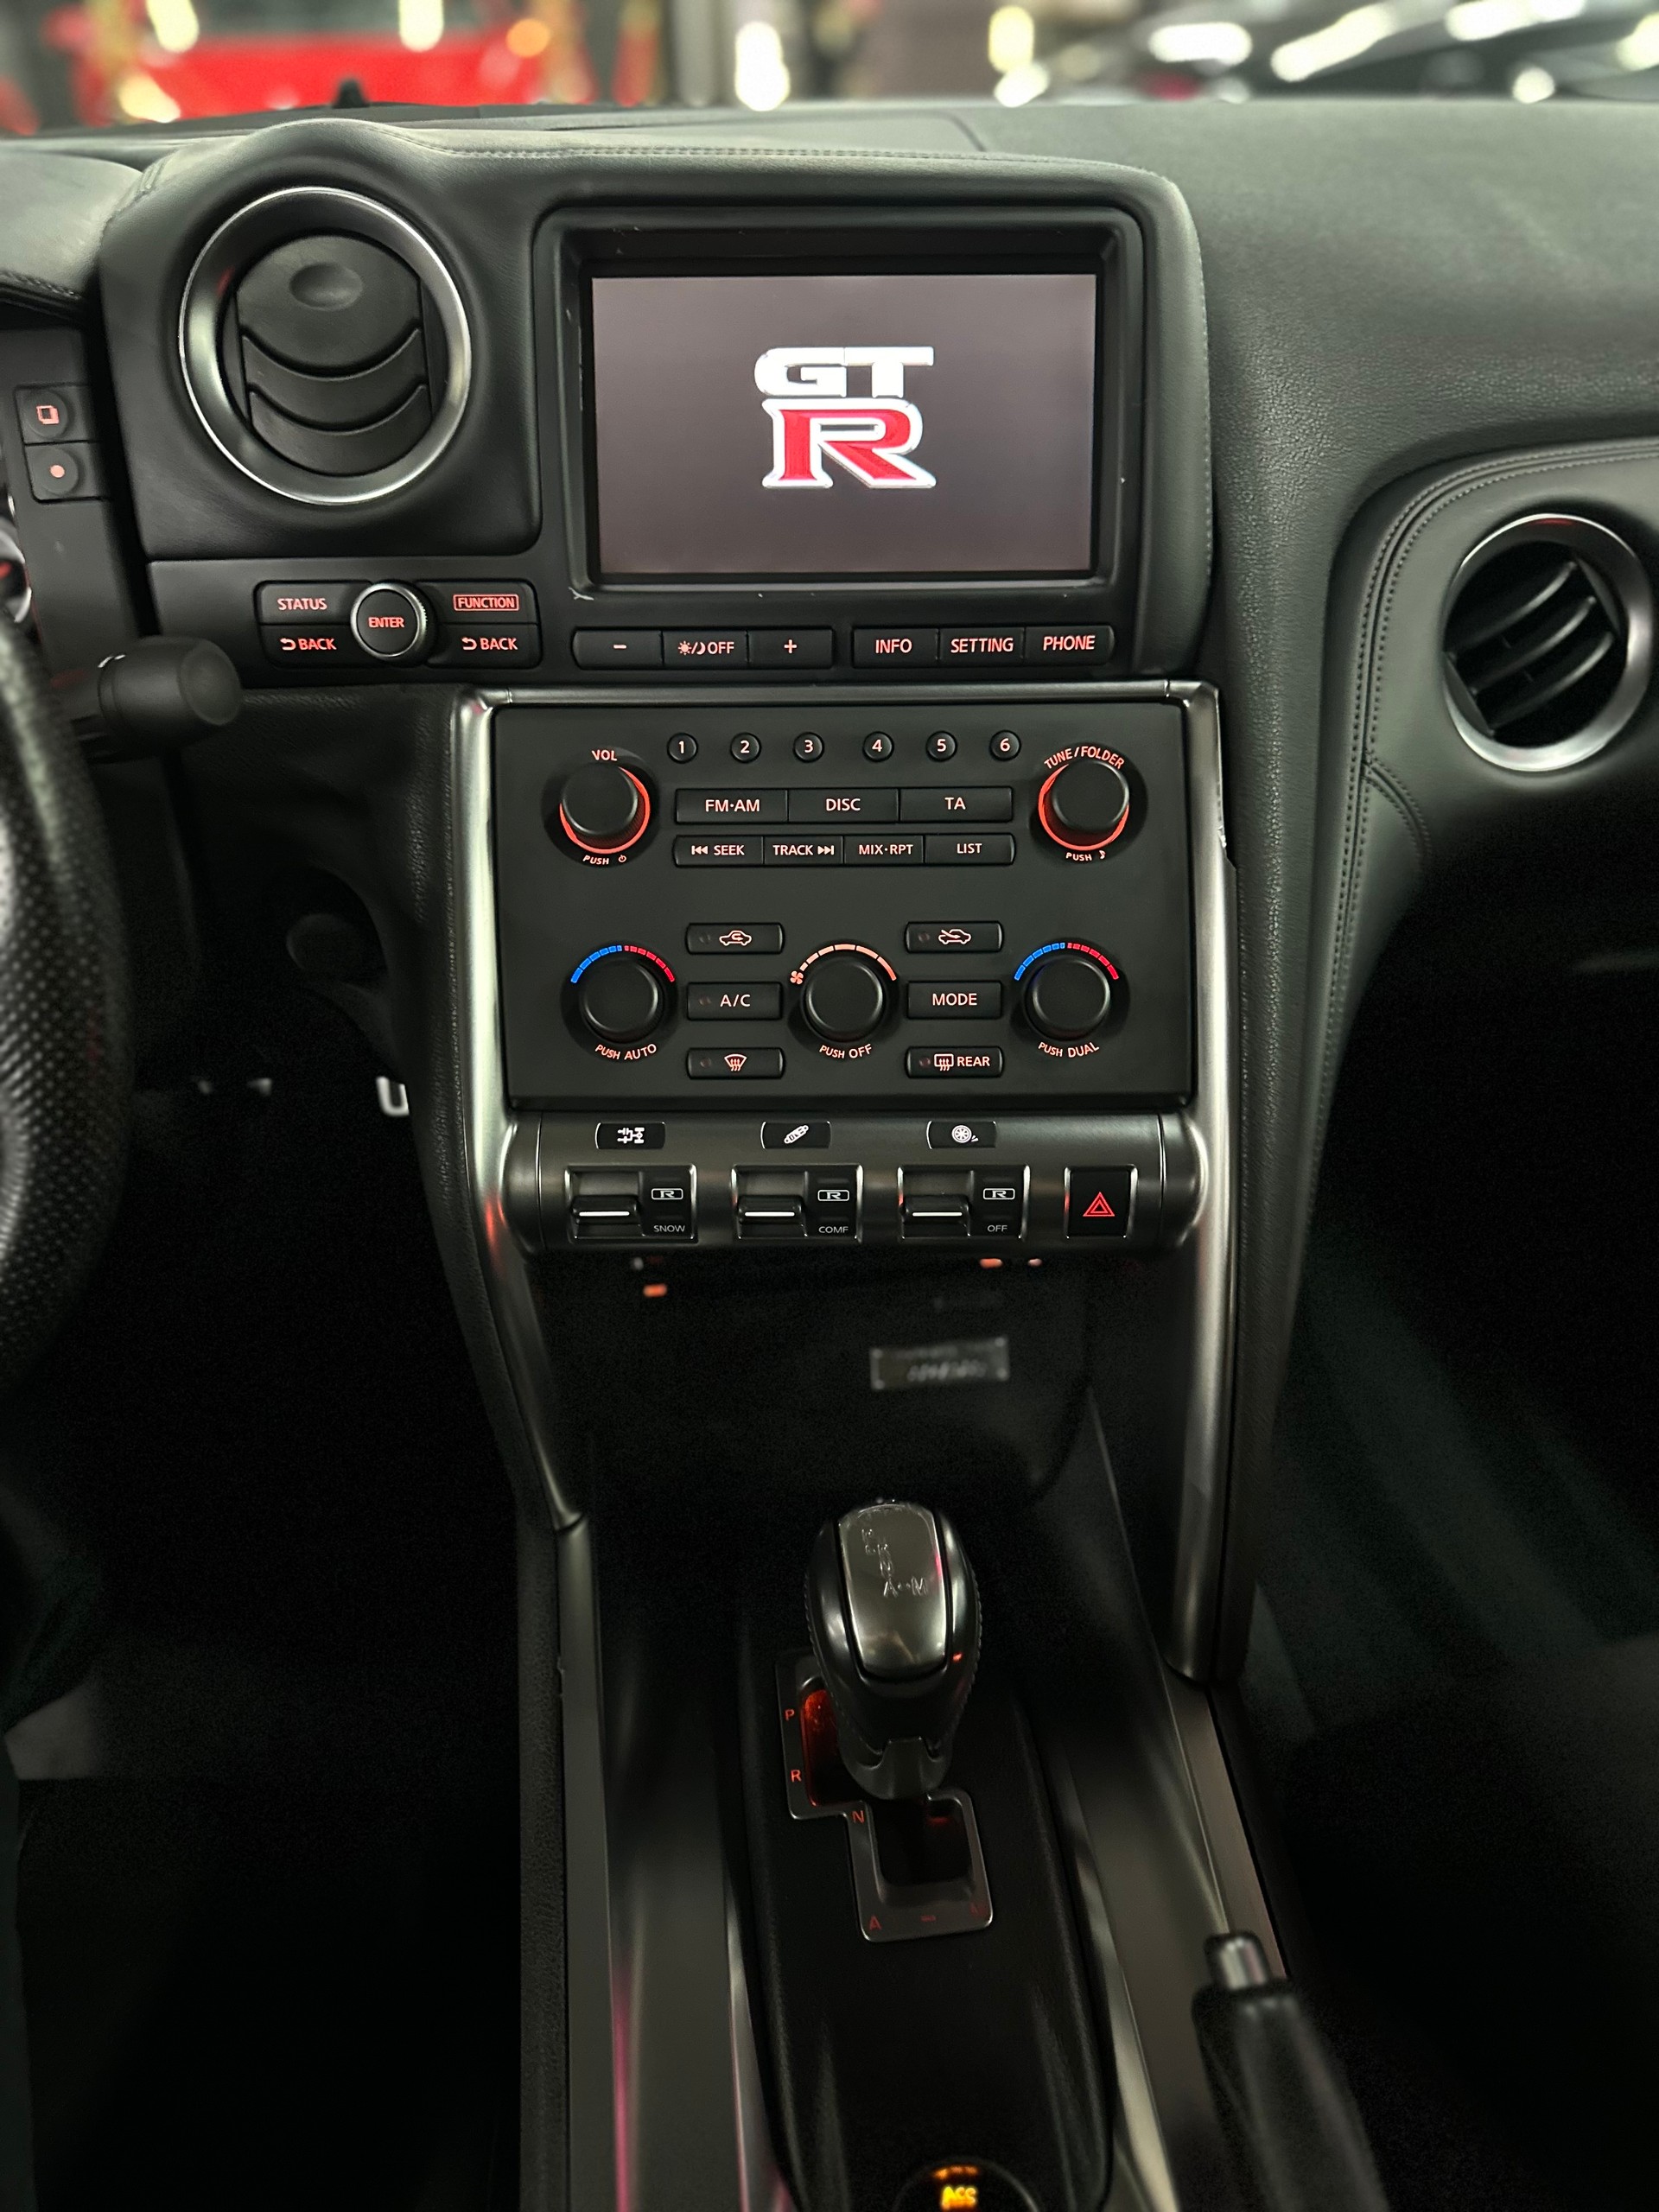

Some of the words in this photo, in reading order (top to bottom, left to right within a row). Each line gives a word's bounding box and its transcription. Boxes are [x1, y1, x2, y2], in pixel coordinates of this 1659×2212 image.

[753, 346, 935, 398] GT
[761, 397, 937, 489] R
[277, 597, 327, 611] STATUS
[456, 596, 516, 609] FUNCTION
[368, 616, 405, 629] ENTER
[298, 638, 337, 651] BACK
[480, 638, 518, 651] BACK
[707, 641, 734, 655] OFF
[874, 638, 912, 653] INFO
[950, 638, 1014, 653] SETTING
[1043, 635, 1096, 651] PHONE
[678, 741, 685, 754] 1
[740, 740, 750, 753] 2
[804, 739, 814, 753] 3
[871, 739, 883, 752] 4
[937, 739, 947, 752] 5
[1000, 738, 1011, 752] 6
[591, 749, 618, 761] VOL
[1043, 746, 1125, 770] TUNE/FOLDER
[825, 798, 861, 811] DISC
[944, 797, 966, 810] TA
[713, 844, 745, 856] SEEK
[772, 844, 813, 856] TRACK
[957, 842, 982, 855] LIST
[582, 854, 610, 866] PUSH
[1065, 851, 1092, 861] PUSH
[720, 994, 751, 1007] A/C
[931, 993, 978, 1006] MODE
[594, 1043, 621, 1060] PUSH
[624, 1043, 657, 1061] AUTO
[818, 1044, 846, 1059] PUSH
[849, 1043, 873, 1059] OFF
[1038, 1041, 1064, 1058] PUSH
[1067, 1041, 1100, 1058] DUAL
[957, 1056, 990, 1067] REAR
[653, 1224, 685, 1233] SNOW
[818, 1225, 849, 1234] COMF
[987, 1224, 1008, 1233] OFF
[785, 1709, 795, 1721] P
[791, 1770, 802, 1783] R
[852, 1810, 865, 1823] N
[869, 1916, 882, 1929] A
